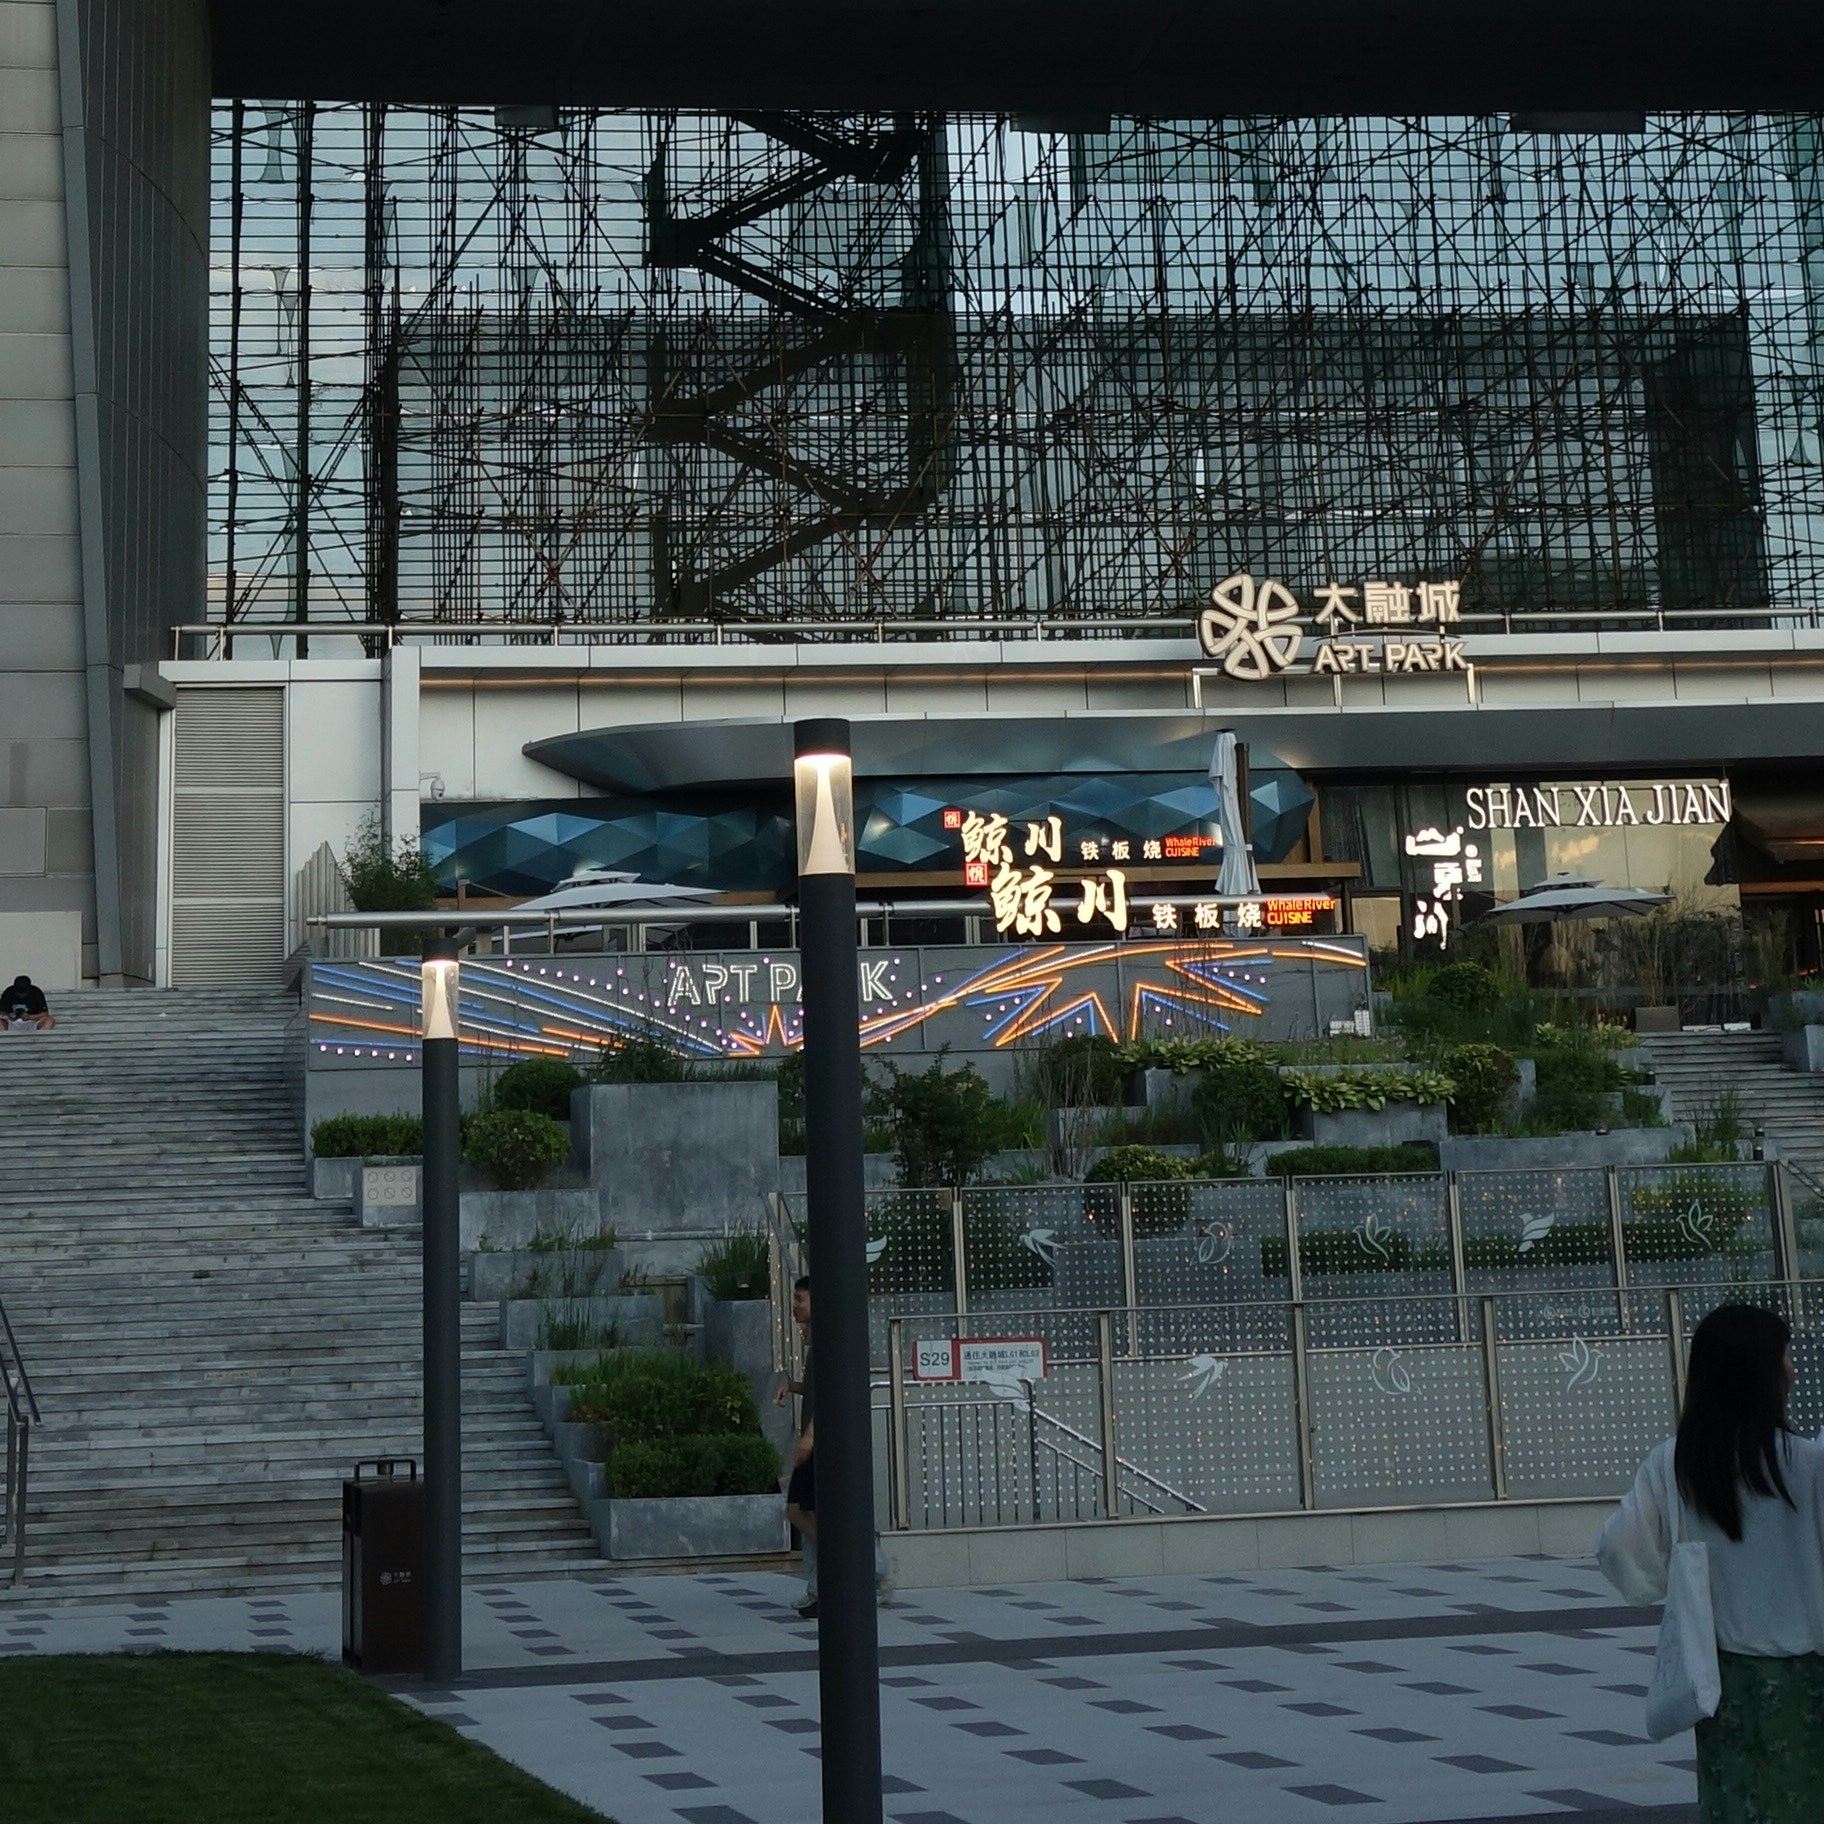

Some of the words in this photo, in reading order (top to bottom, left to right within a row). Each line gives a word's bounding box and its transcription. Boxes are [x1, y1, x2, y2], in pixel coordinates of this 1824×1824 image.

[1312, 580, 1461, 624] 大融城
[1313, 643, 1374, 672] ART
[1383, 641, 1468, 672] PARK
[1466, 787, 1561, 830] SHAN
[1573, 784, 1640, 827] XIA
[1646, 783, 1732, 825] JIAN
[961, 810, 1063, 865] 鲸川
[1081, 840, 1163, 862] 铁板烧
[1165, 847, 1200, 857] CUISINE
[991, 862, 1127, 936] 鲸川
[1152, 902, 1262, 930] 铁板烧
[1267, 911, 1313, 925] CUISINE
[667, 964, 758, 1006] ART
[769, 960, 894, 1002] PK
[920, 1352, 950, 1366] S29
